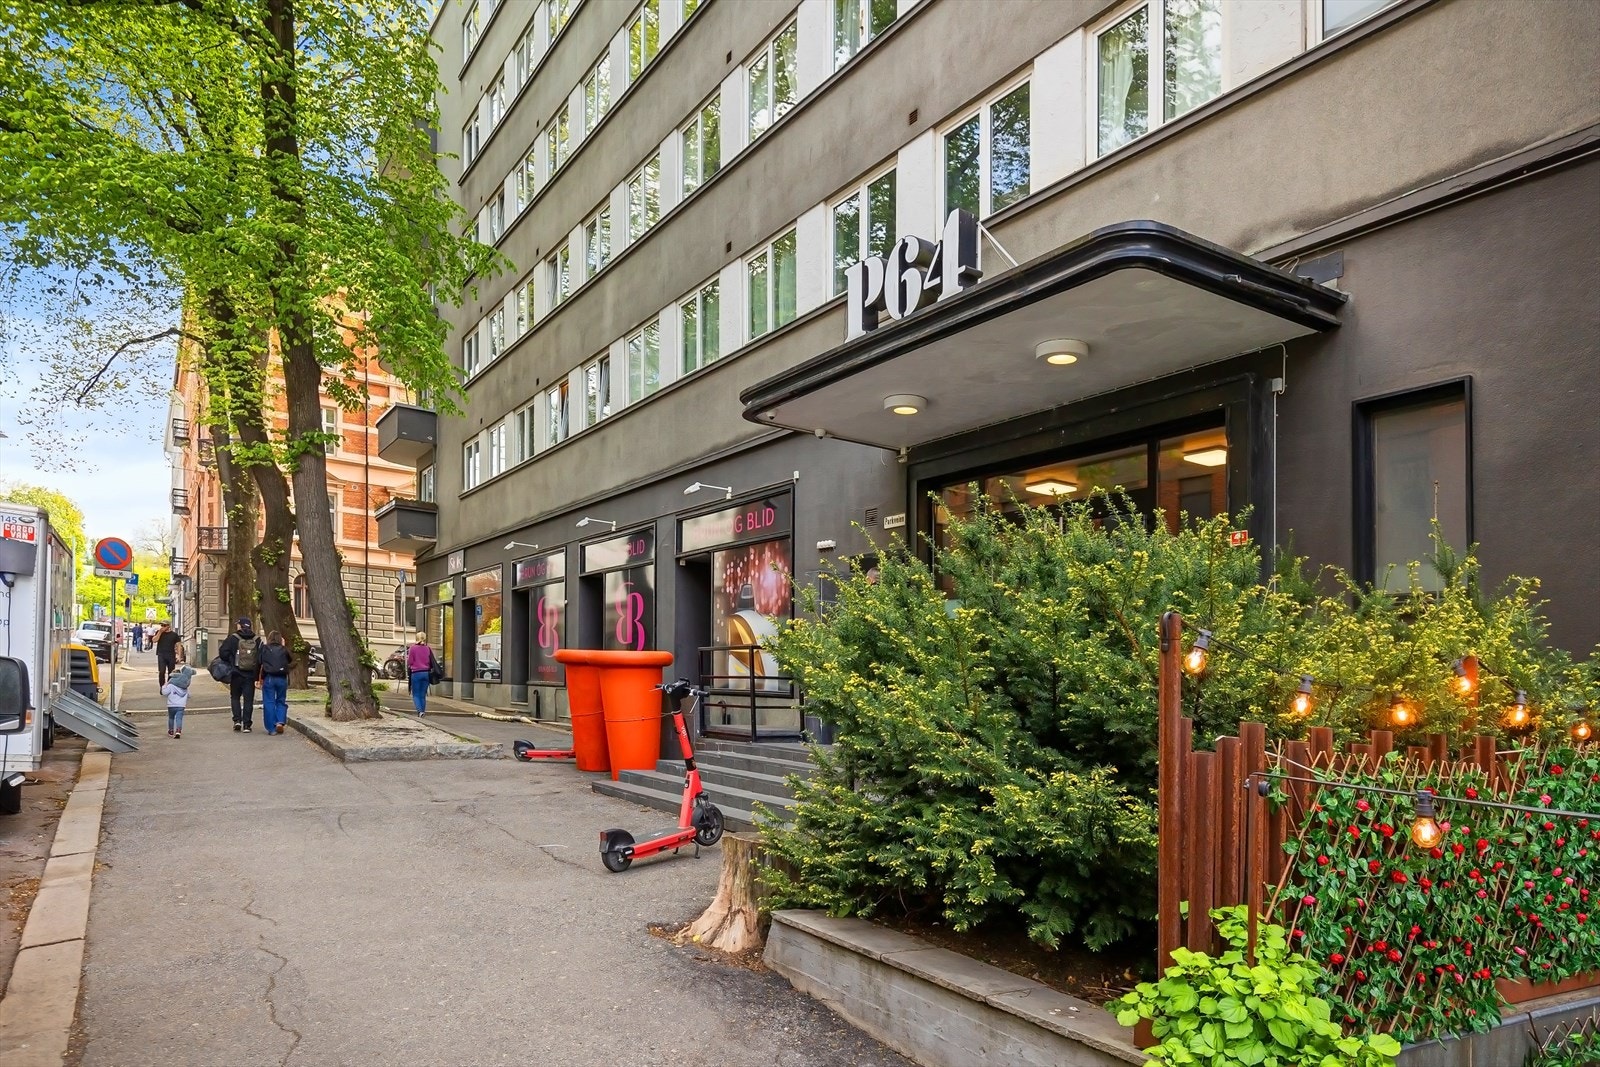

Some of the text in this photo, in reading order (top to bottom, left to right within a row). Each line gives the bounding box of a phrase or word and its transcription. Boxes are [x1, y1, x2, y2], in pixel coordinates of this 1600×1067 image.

[844, 208, 976, 343] P64
[0, 514, 17, 523] 145
[746, 507, 775, 530] BLID
[5, 524, 34, 534] CARGO
[11, 531, 28, 539] VAN
[628, 539, 645, 557] BLID
